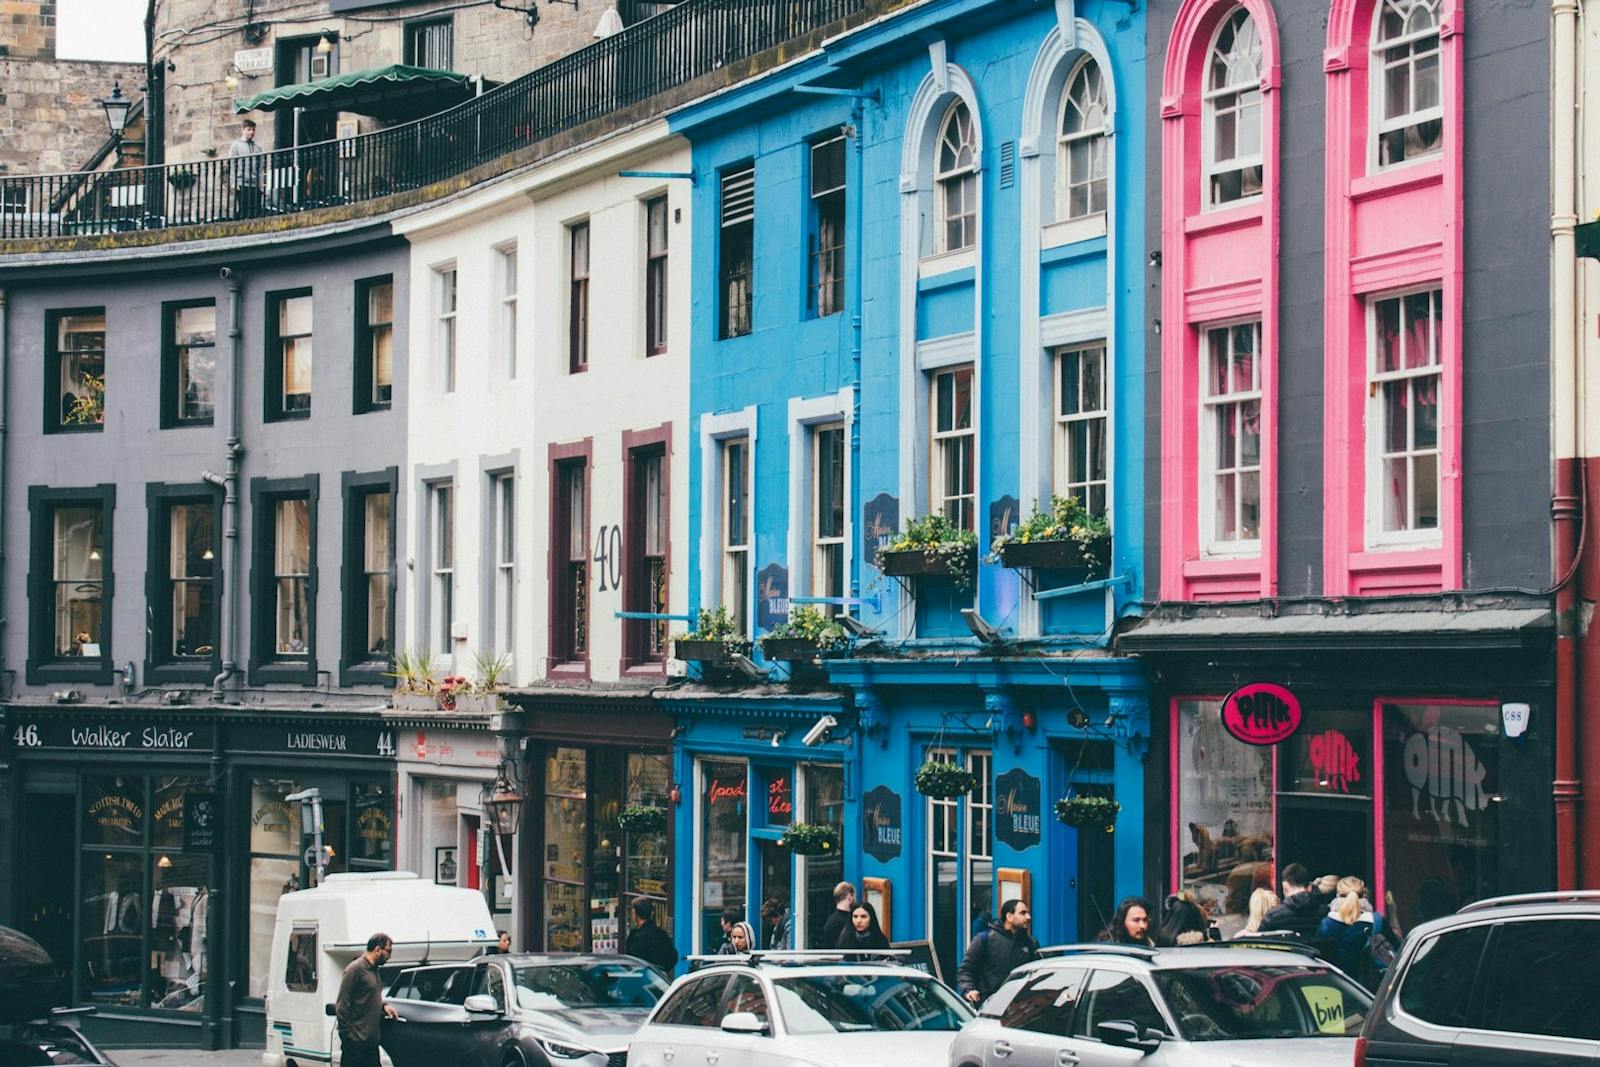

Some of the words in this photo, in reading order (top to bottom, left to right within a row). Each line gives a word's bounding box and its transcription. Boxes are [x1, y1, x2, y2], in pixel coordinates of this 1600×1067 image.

[594, 525, 621, 592] 40
[13, 724, 42, 746] 46.
[71, 725, 131, 747] Walker
[142, 727, 193, 748] Slater
[287, 733, 347, 750] LADIESWEAR
[377, 732, 395, 756] 44.
[709, 779, 745, 805] food
[1013, 814, 1040, 834] BLEUE
[878, 827, 901, 845] BLEUE
[1314, 997, 1342, 1026] bin
